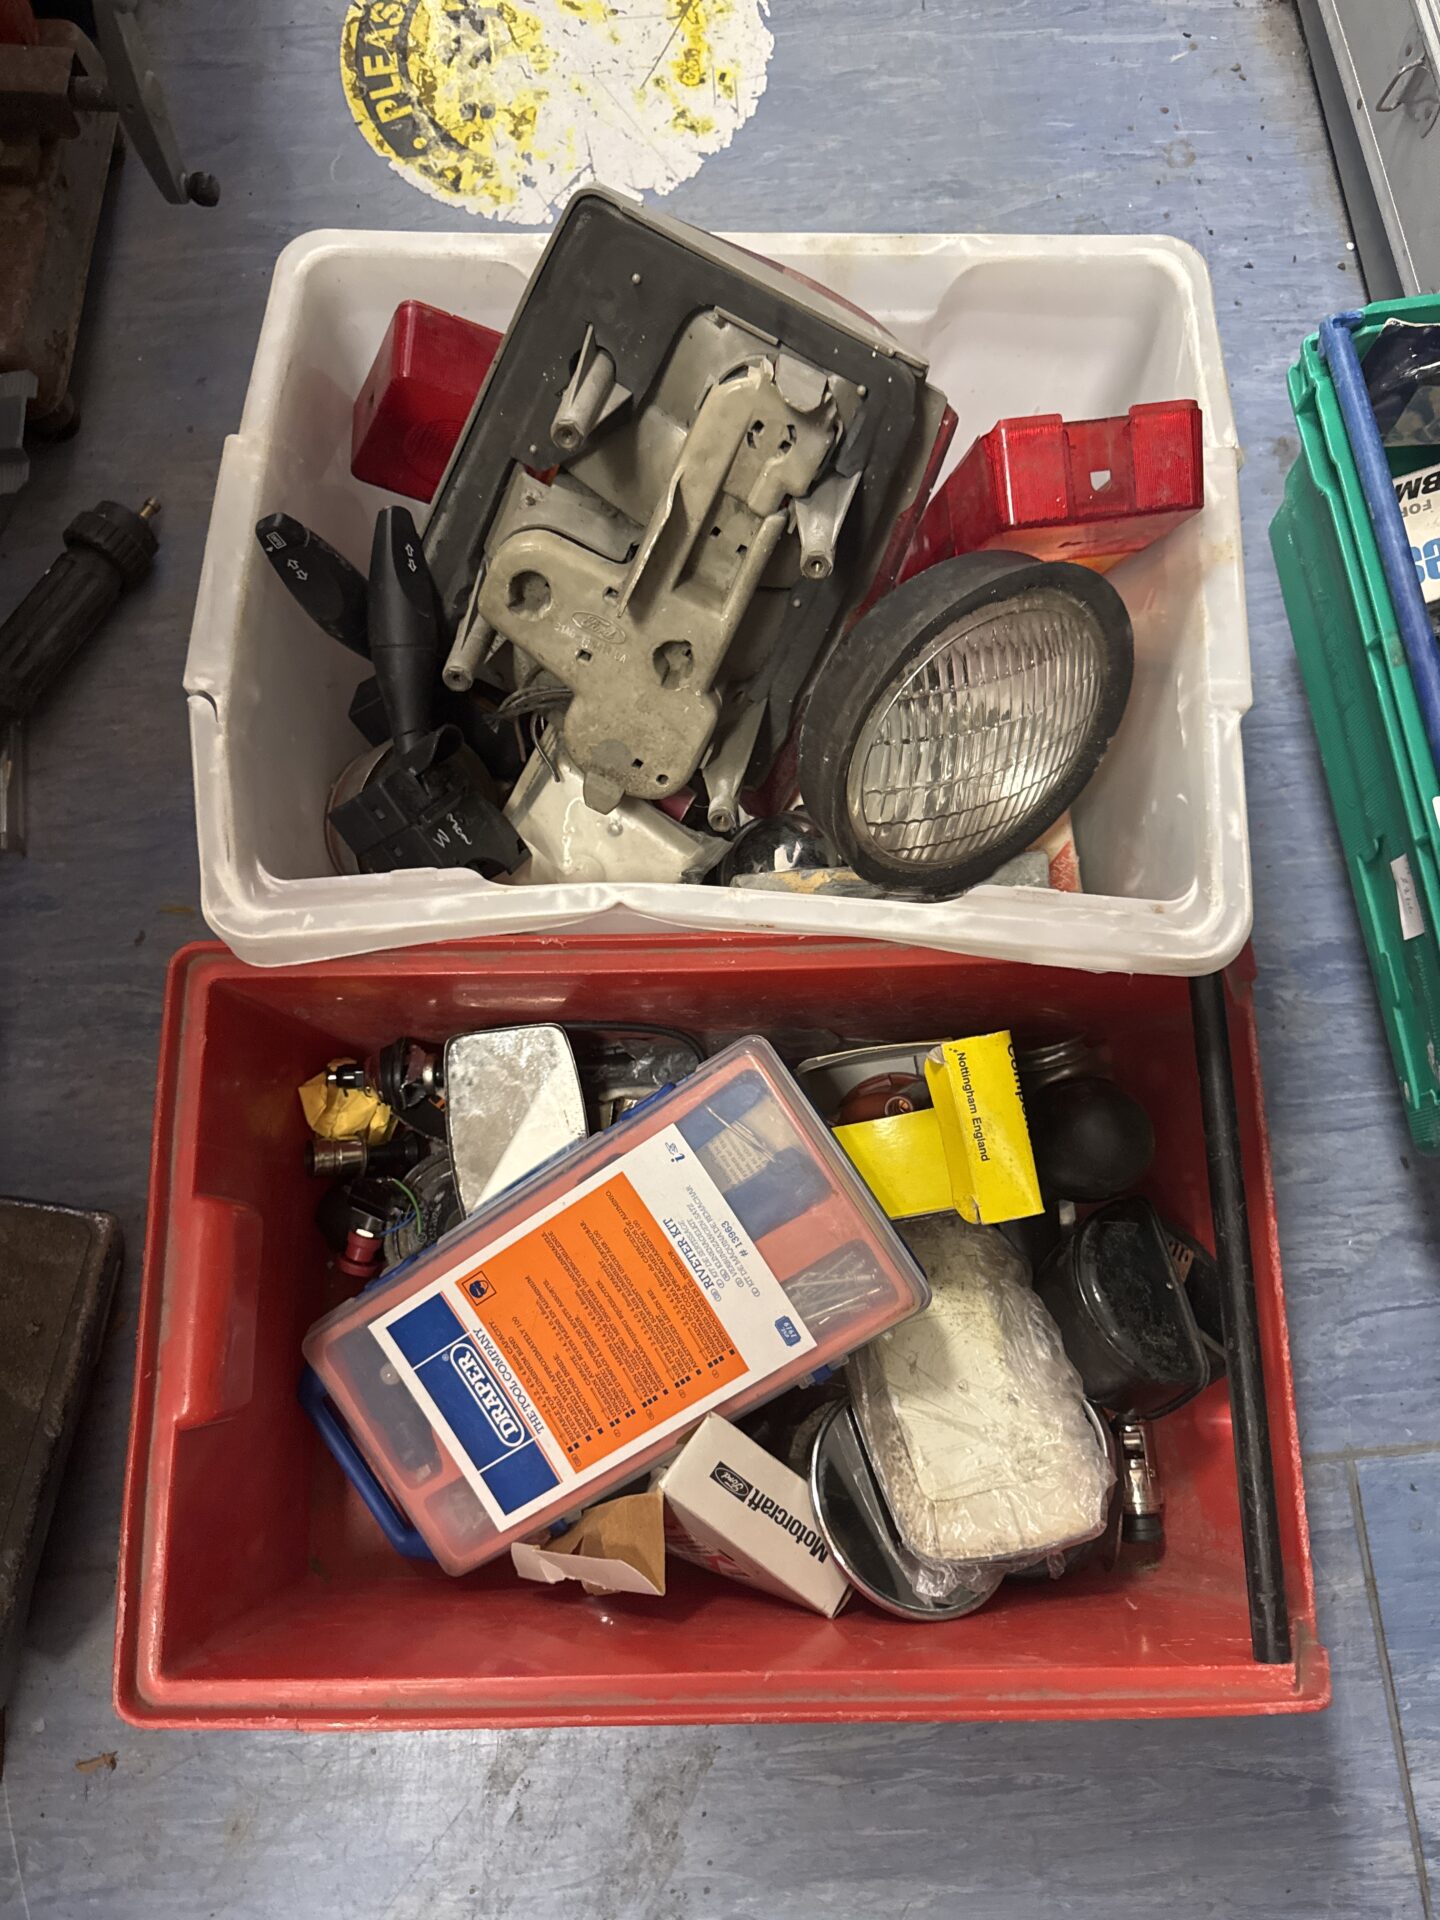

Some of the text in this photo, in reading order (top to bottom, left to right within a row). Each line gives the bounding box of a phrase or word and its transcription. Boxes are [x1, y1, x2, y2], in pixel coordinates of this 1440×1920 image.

[957, 1052, 991, 1162] Nottingham England
[661, 1214, 682, 1239] KIT
[720, 1218, 743, 1248] 13963
[675, 1235, 715, 1290] RIVETER
[506, 1334, 524, 1357] BLIND
[453, 1349, 520, 1438] DRAPER
[471, 1325, 546, 1434] THE TOOL COMPANY
[552, 1382, 569, 1402] WITH
[543, 1393, 557, 1410] FOR
[563, 1400, 590, 1435] SUPPLIED
[567, 1393, 595, 1432] ASSORTED
[552, 1408, 577, 1442] SUITABLE
[563, 1412, 583, 1439] RIVETS
[747, 1488, 829, 1564] Motorcraft
